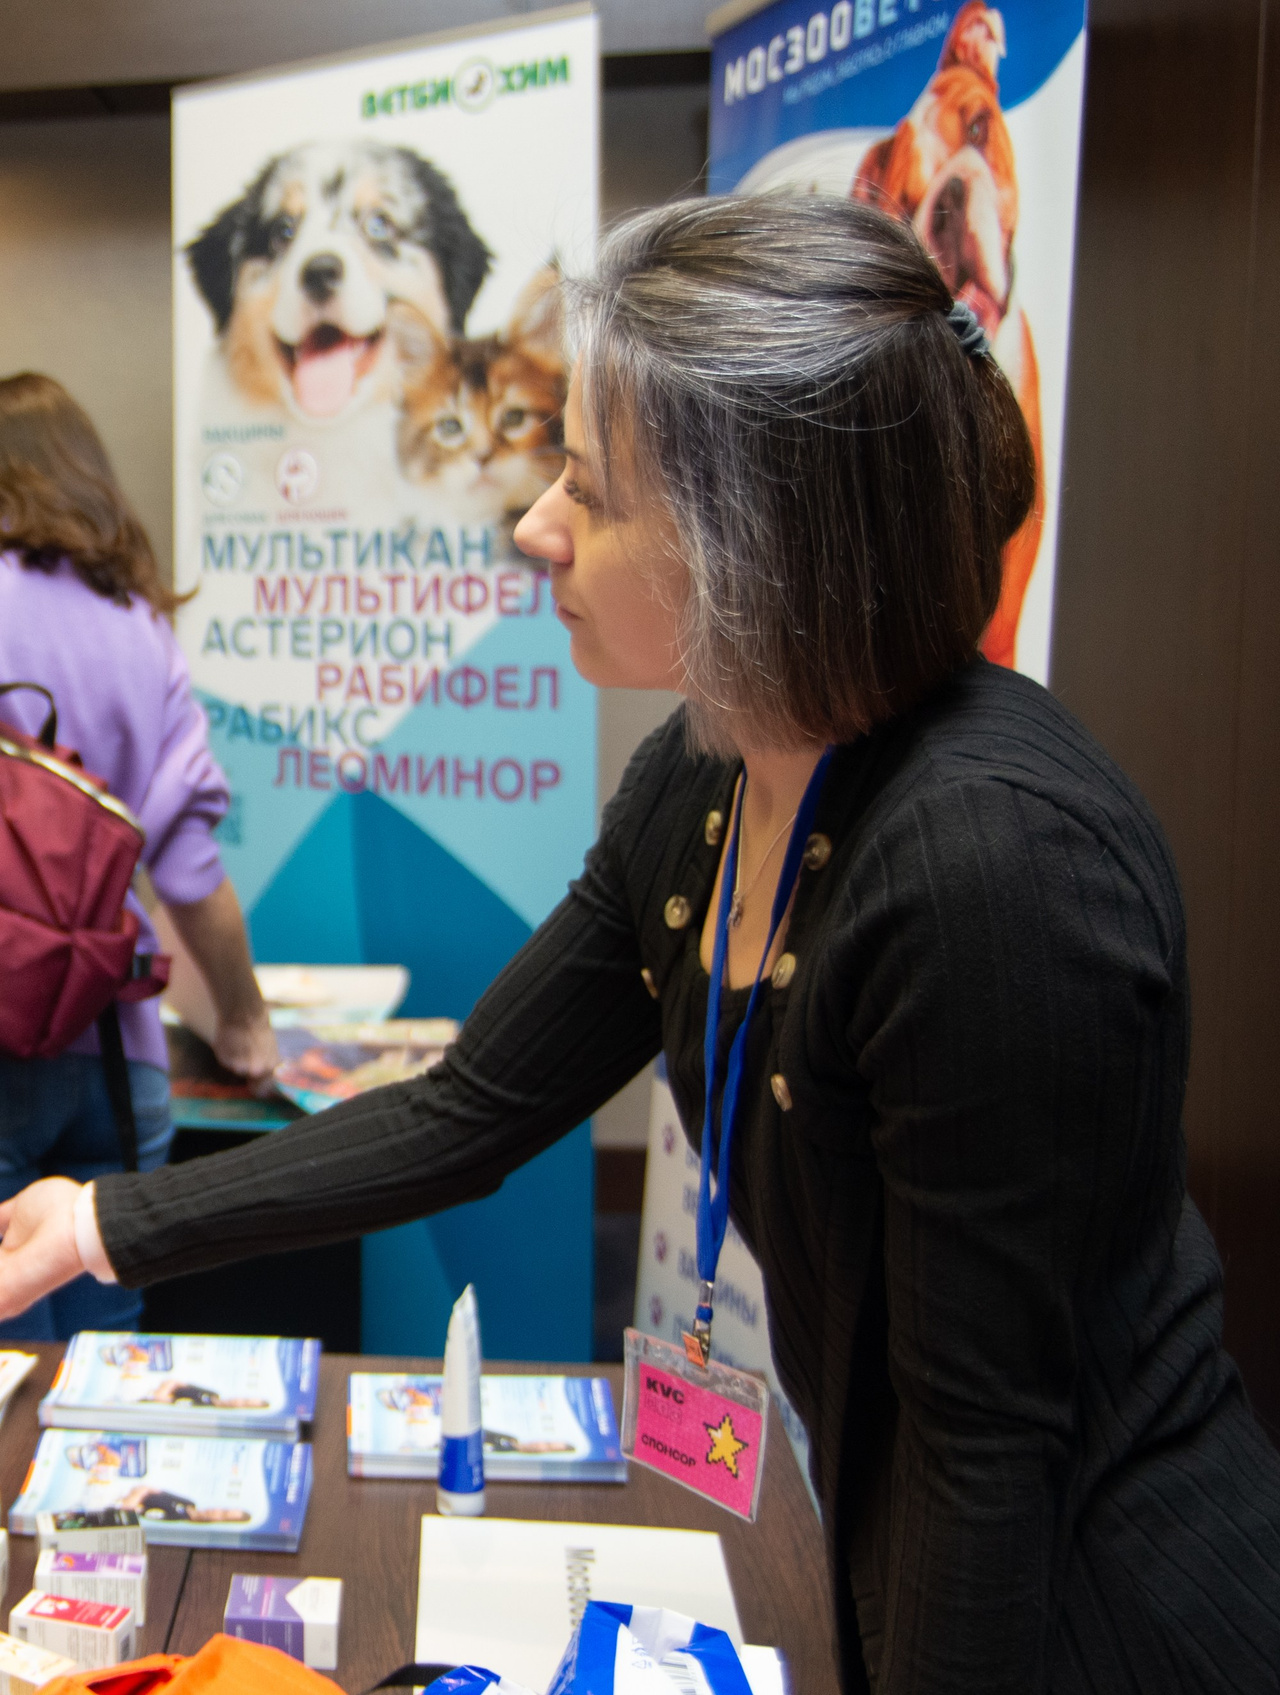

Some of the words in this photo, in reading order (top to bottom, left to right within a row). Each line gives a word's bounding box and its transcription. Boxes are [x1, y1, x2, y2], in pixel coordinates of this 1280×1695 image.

[724, 0, 919, 106] МОСЗООВЕ
[202, 528, 492, 572] МУЛЬТИКАН
[202, 617, 453, 660] АСТЕРИОН
[317, 663, 559, 711] РАБИФЕЛ
[206, 703, 381, 748] РАБИКС
[273, 748, 561, 804] ЛЕОМИНОР
[646, 1377, 686, 1406] KVC
[641, 1433, 697, 1468] СПОНСОР
